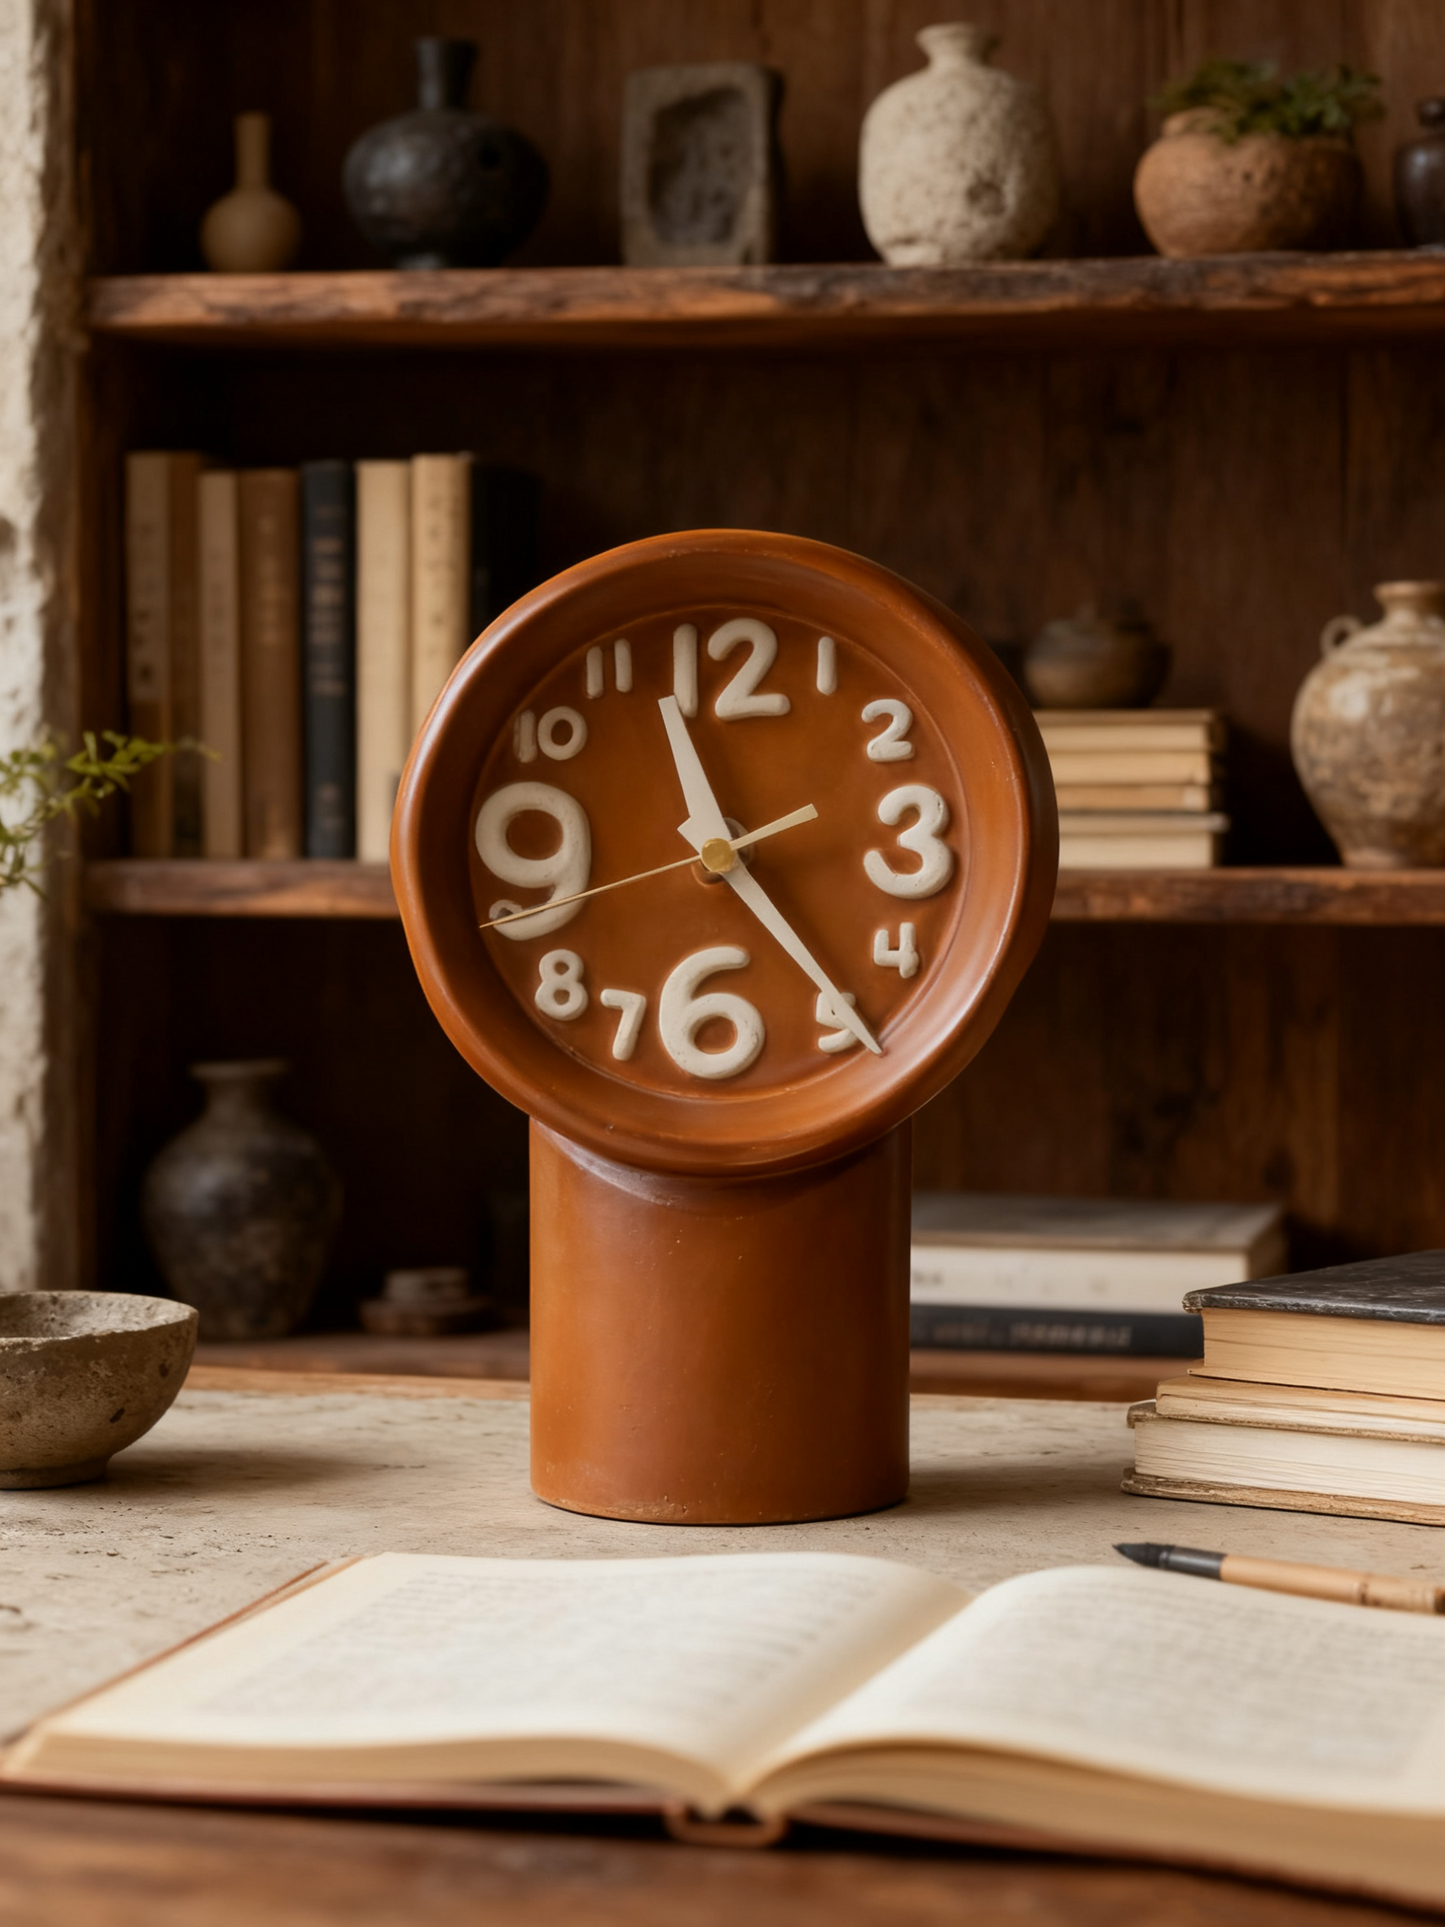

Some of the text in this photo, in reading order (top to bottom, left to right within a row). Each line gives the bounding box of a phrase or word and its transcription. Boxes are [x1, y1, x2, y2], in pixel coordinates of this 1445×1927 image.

[586, 638, 633, 699] 11
[673, 618, 791, 722] 12
[817, 636, 838, 695] 1
[514, 706, 588, 763] 10
[861, 699, 915, 762] 2
[476, 782, 592, 940] 9
[863, 785, 954, 899] 3
[535, 949, 588, 1021] 8
[874, 922, 920, 979] 4
[600, 989, 647, 1060] 7
[658, 946, 765, 1079] 6
